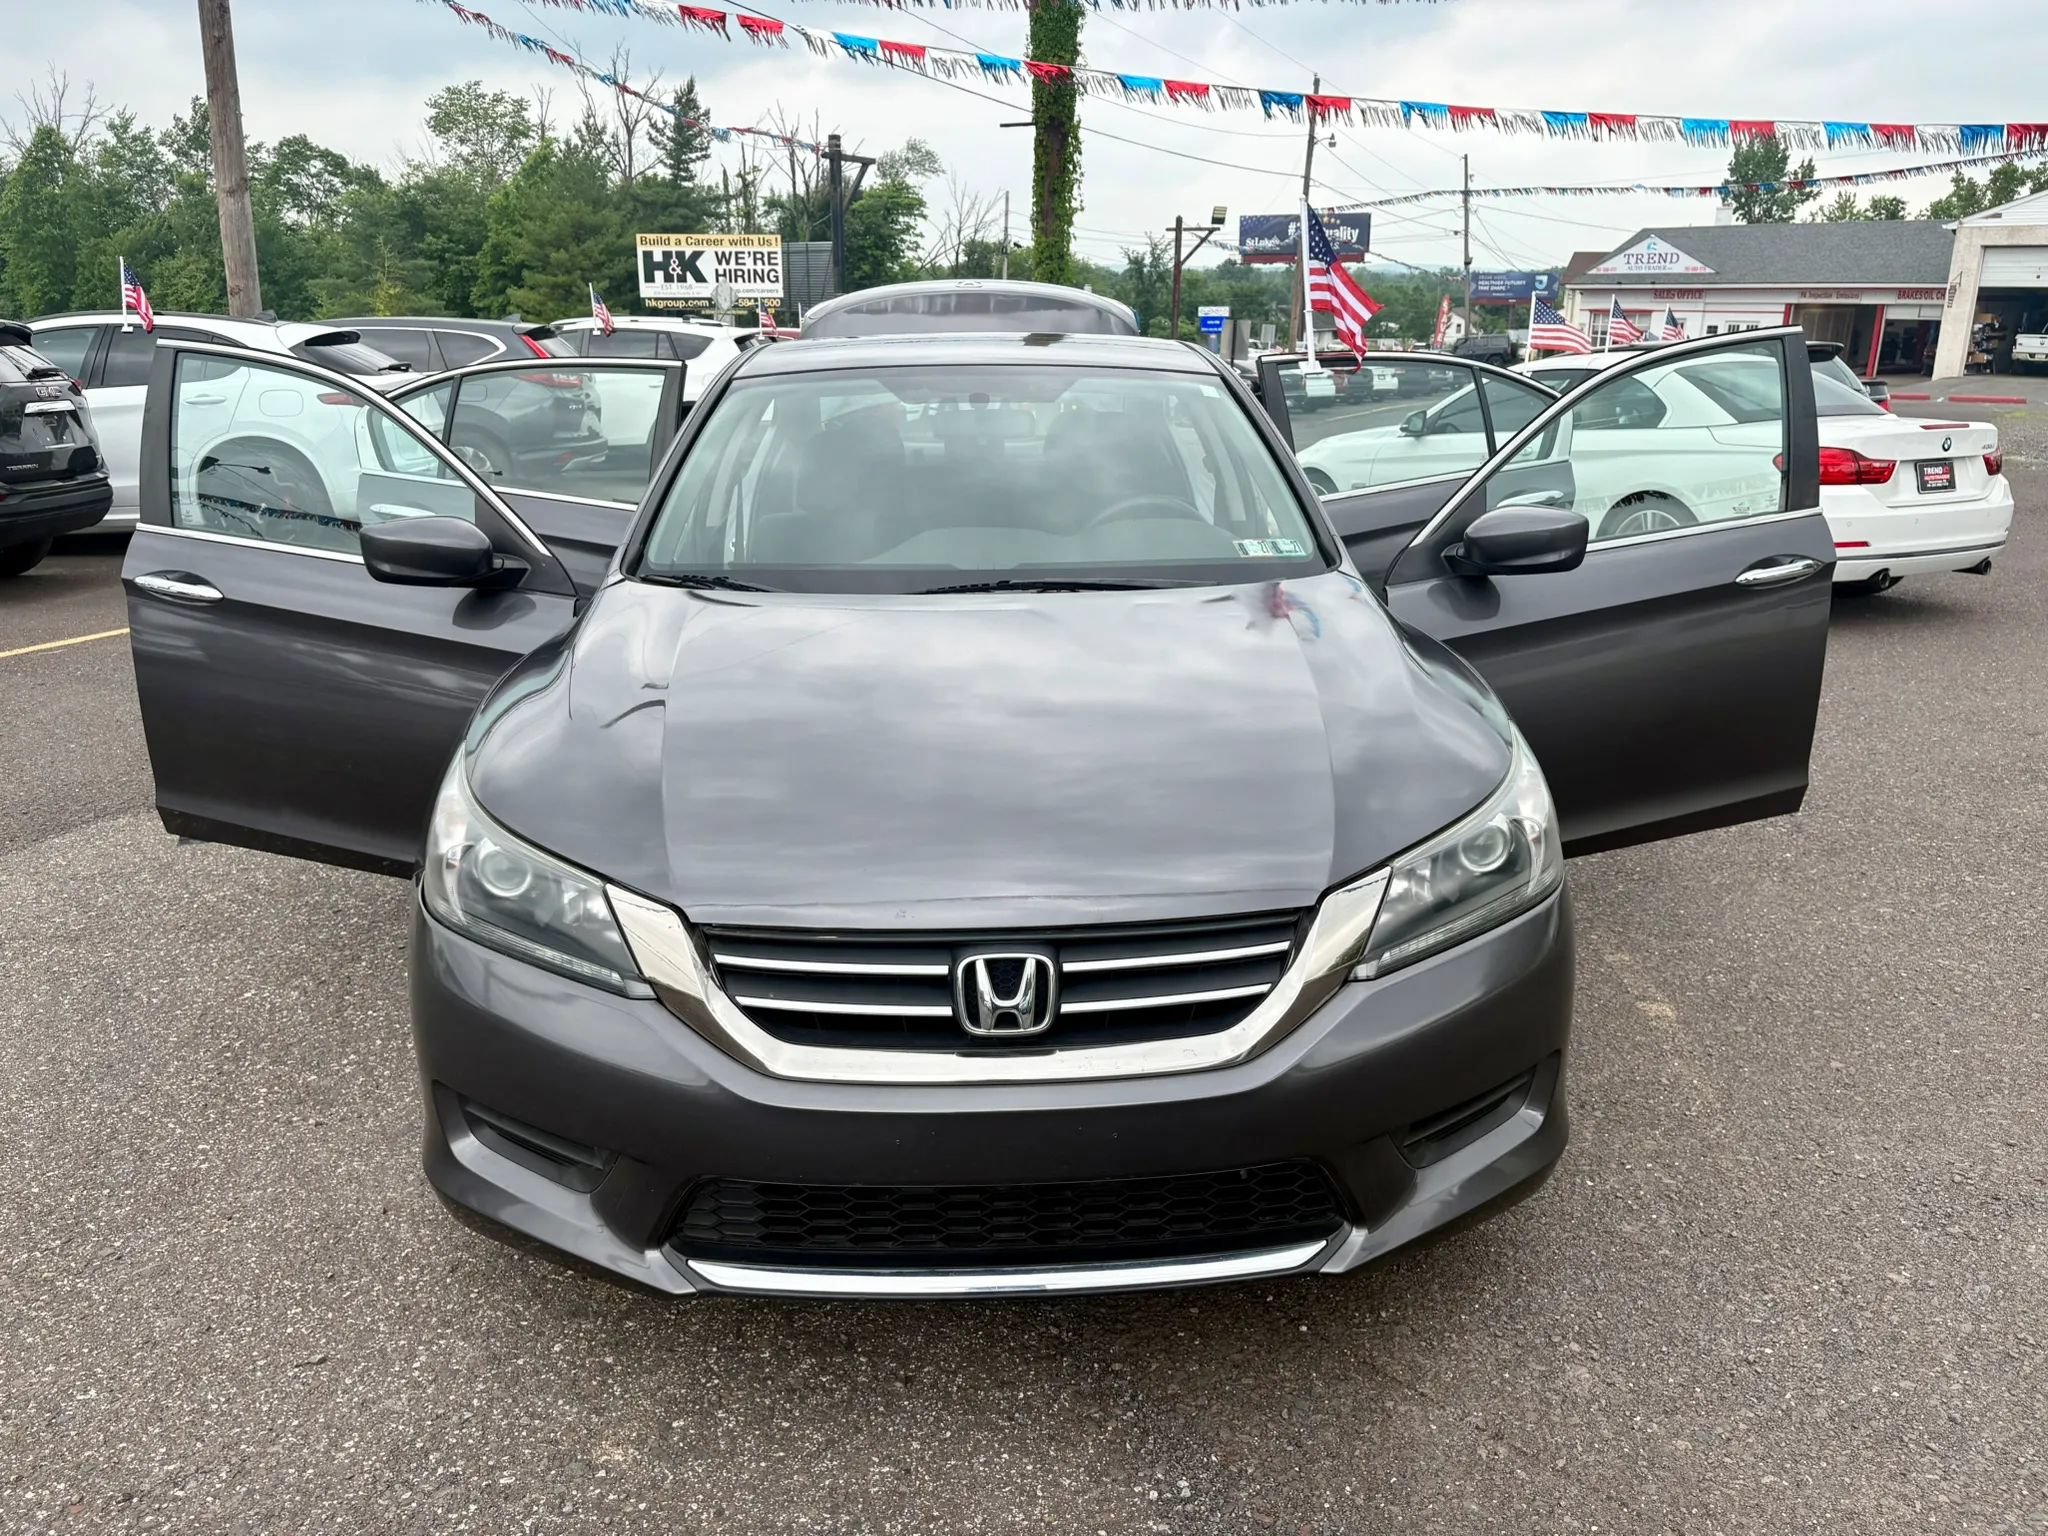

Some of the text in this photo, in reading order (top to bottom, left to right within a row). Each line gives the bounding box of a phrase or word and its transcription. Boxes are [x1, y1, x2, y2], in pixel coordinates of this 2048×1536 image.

[1324, 226, 1359, 242] uality
[640, 236, 671, 246] Build
[686, 237, 725, 246] Career
[728, 236, 754, 246] with
[715, 251, 779, 266] WE'RE
[1624, 252, 1680, 265] TREND
[642, 250, 708, 283] H&K
[715, 268, 780, 284] HIRING
[1653, 289, 1704, 300] SALES OFFICE
[1897, 290, 1923, 300] BRAKES
[1924, 290, 1935, 300] OIL
[645, 298, 709, 309] hkgroup.com
[1924, 467, 1943, 475] TREND
